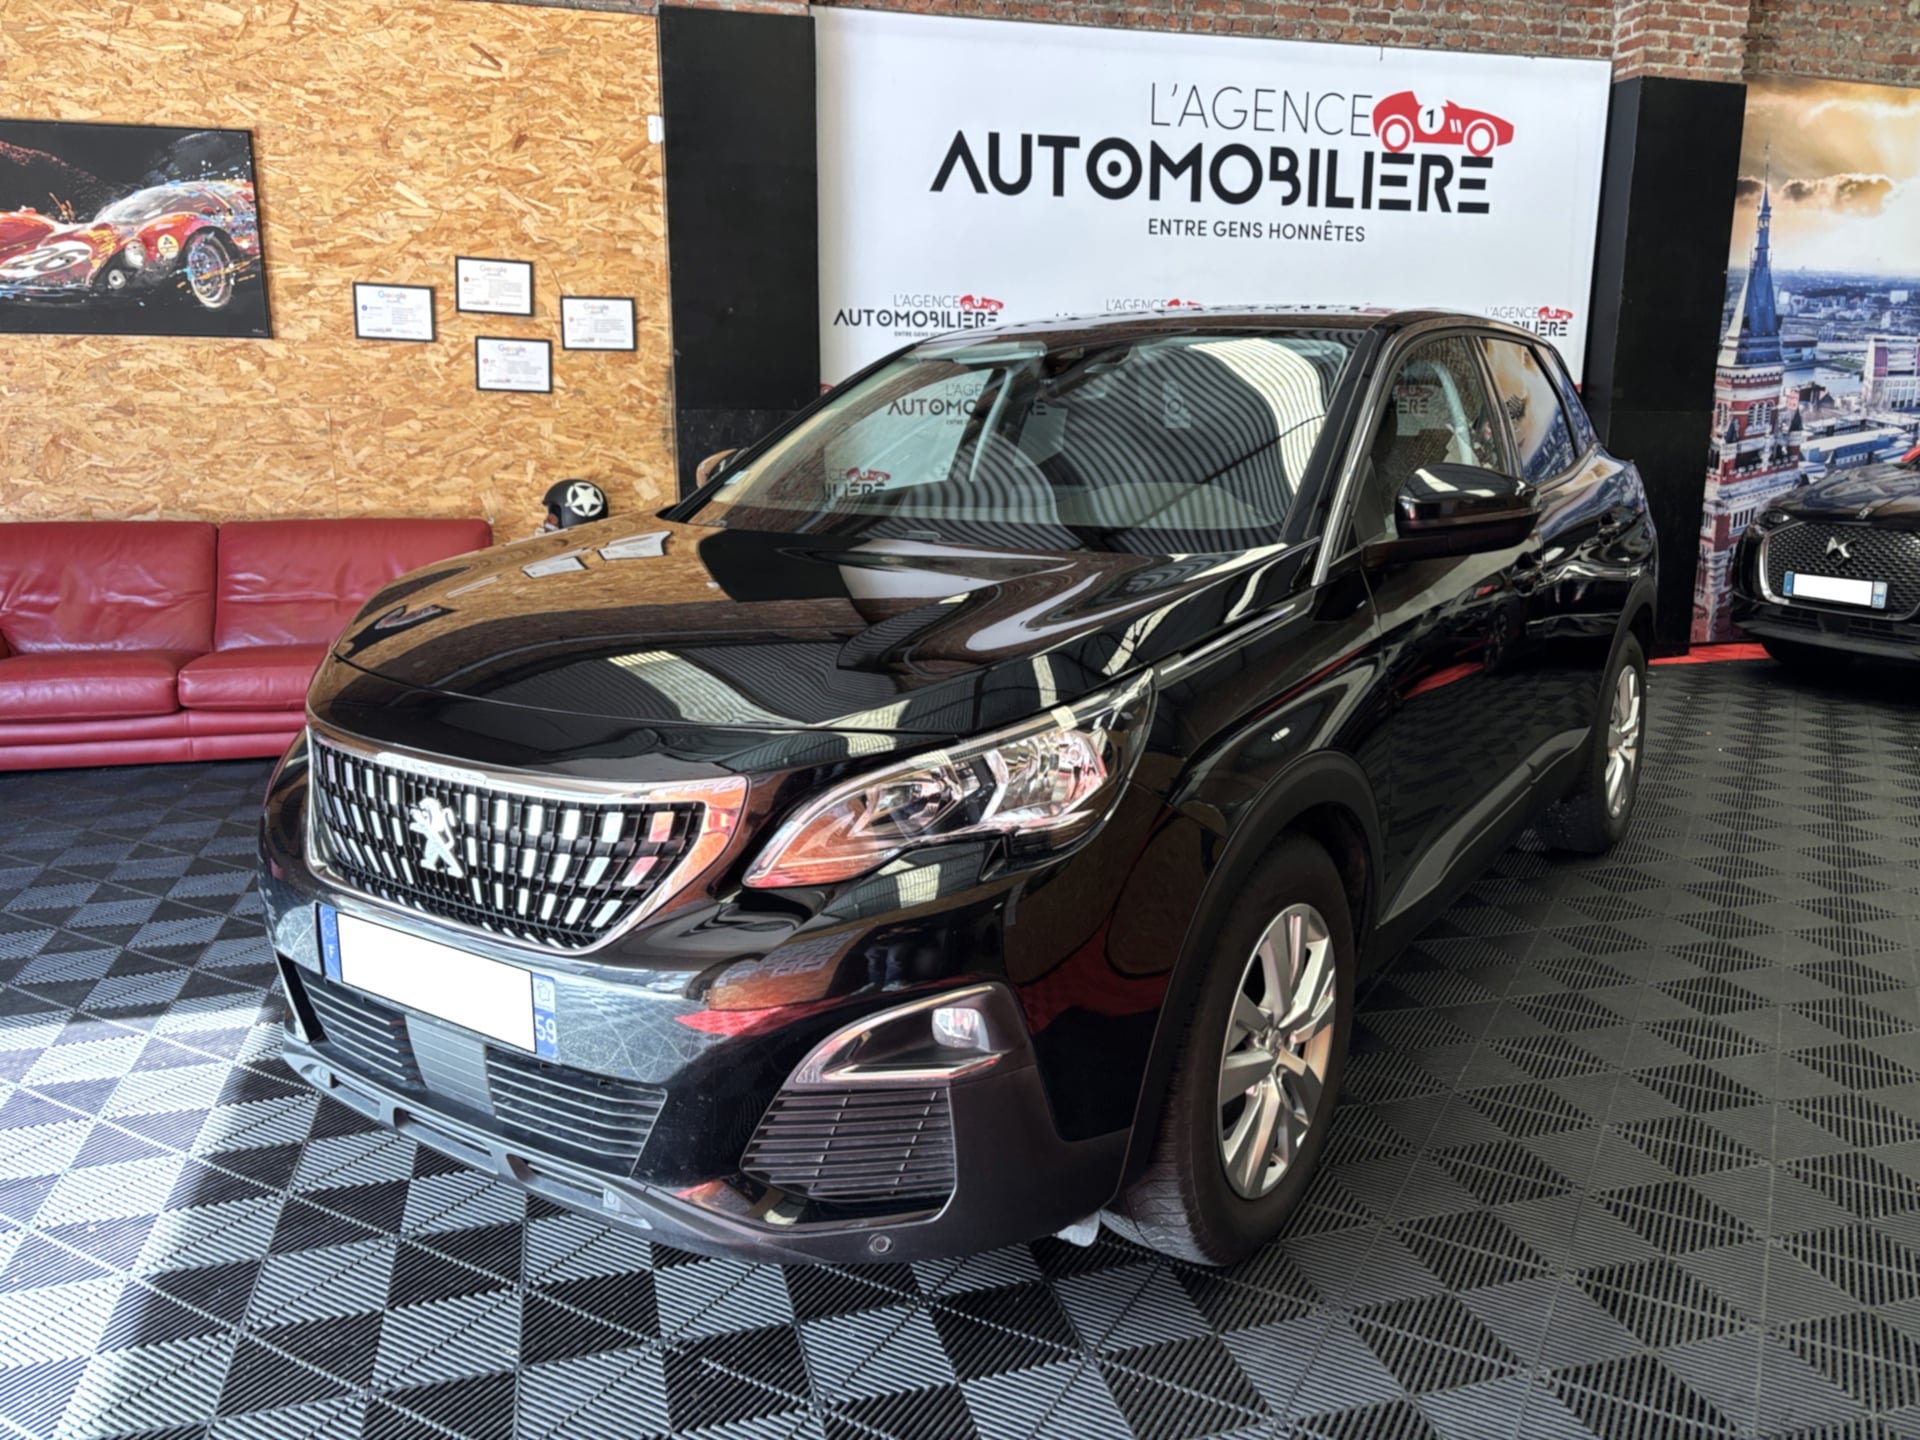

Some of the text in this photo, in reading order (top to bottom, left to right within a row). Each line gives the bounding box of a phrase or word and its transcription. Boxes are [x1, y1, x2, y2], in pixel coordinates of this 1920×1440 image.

[1150, 82, 1374, 137] L'AGENCE
[1425, 108, 1435, 129] 1
[929, 129, 1494, 214] AUTOMOBILIERE
[1148, 218, 1366, 242] ENTRE GENS HONNÊTES
[893, 294, 960, 309] L'AGENCE
[833, 308, 999, 329] AUTOMOBILIERE
[945, 383, 983, 397] L'AGE
[534, 1013, 557, 1044] 59
